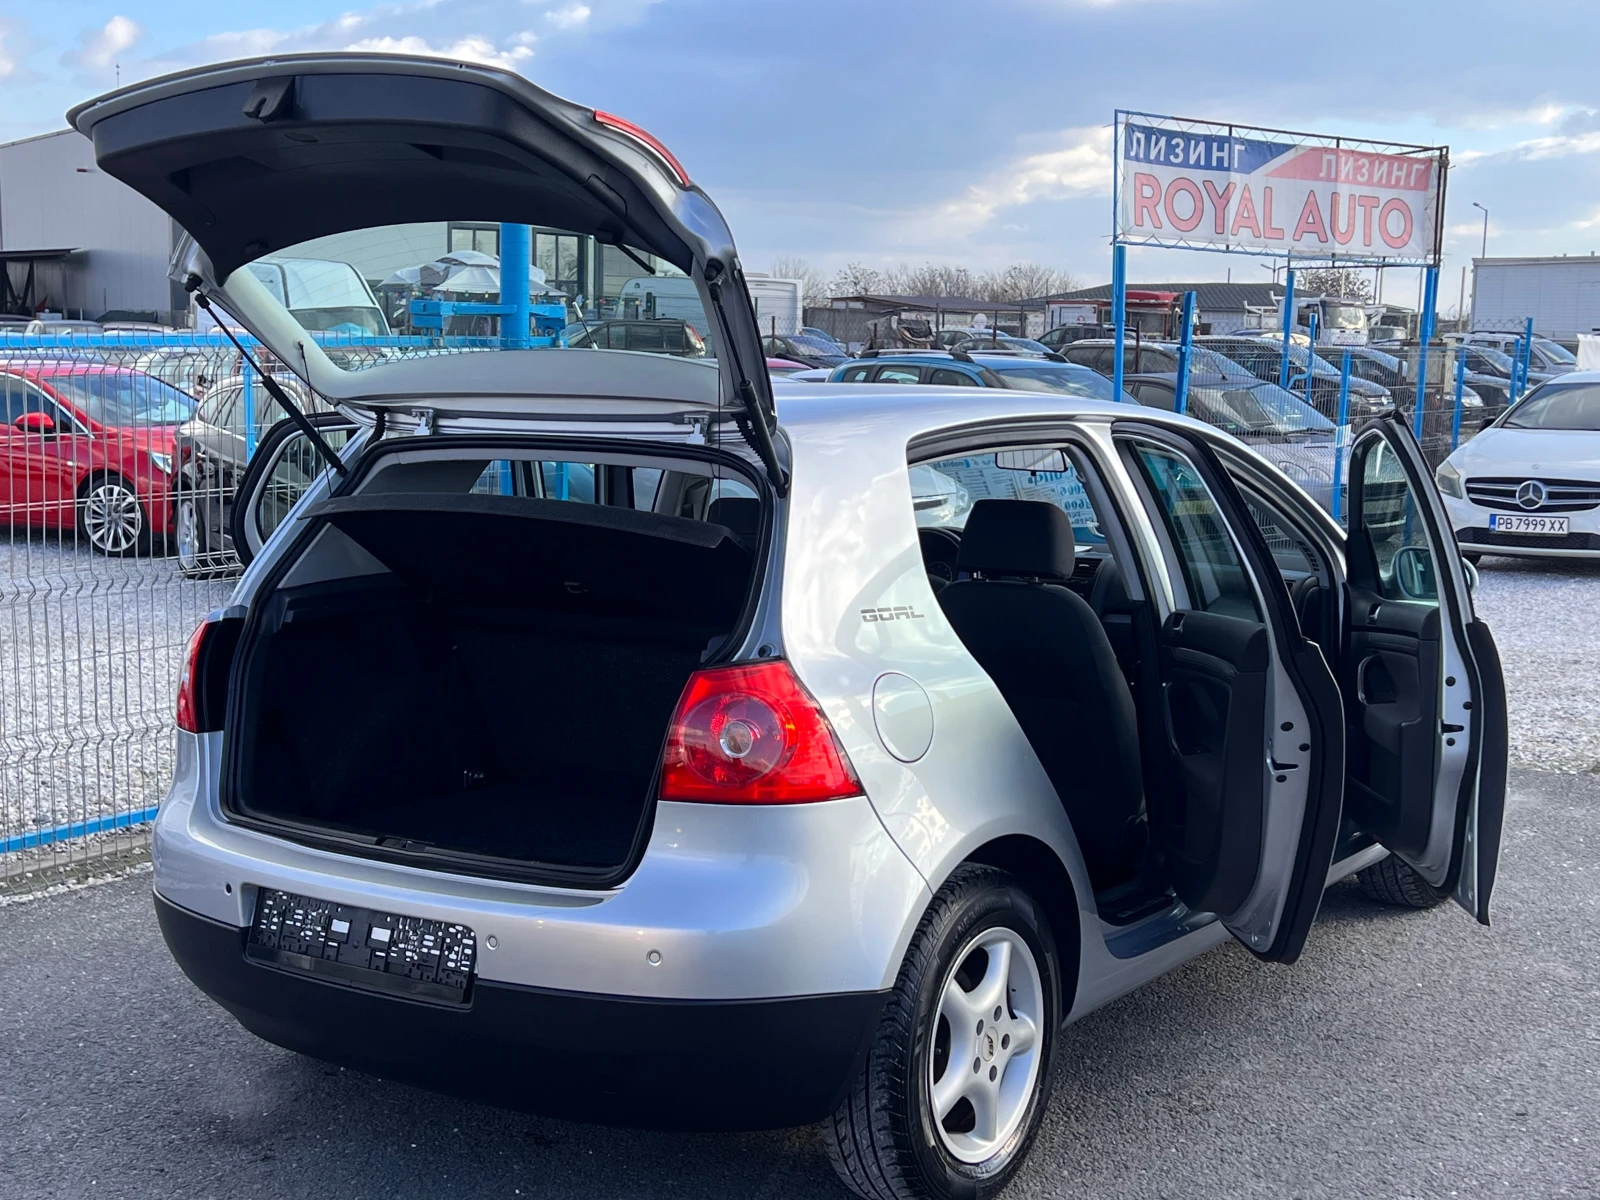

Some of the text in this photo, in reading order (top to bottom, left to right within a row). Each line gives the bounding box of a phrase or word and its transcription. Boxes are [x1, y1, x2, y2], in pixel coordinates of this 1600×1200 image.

[1130, 131, 1246, 169] ЛИЗИНГ
[1319, 153, 1425, 187] ЛИЗИНГ
[1134, 171, 1413, 249] ROYAL AUTO
[1497, 517, 1566, 532] PB 7999 XX
[860, 605, 925, 623] GOAL
